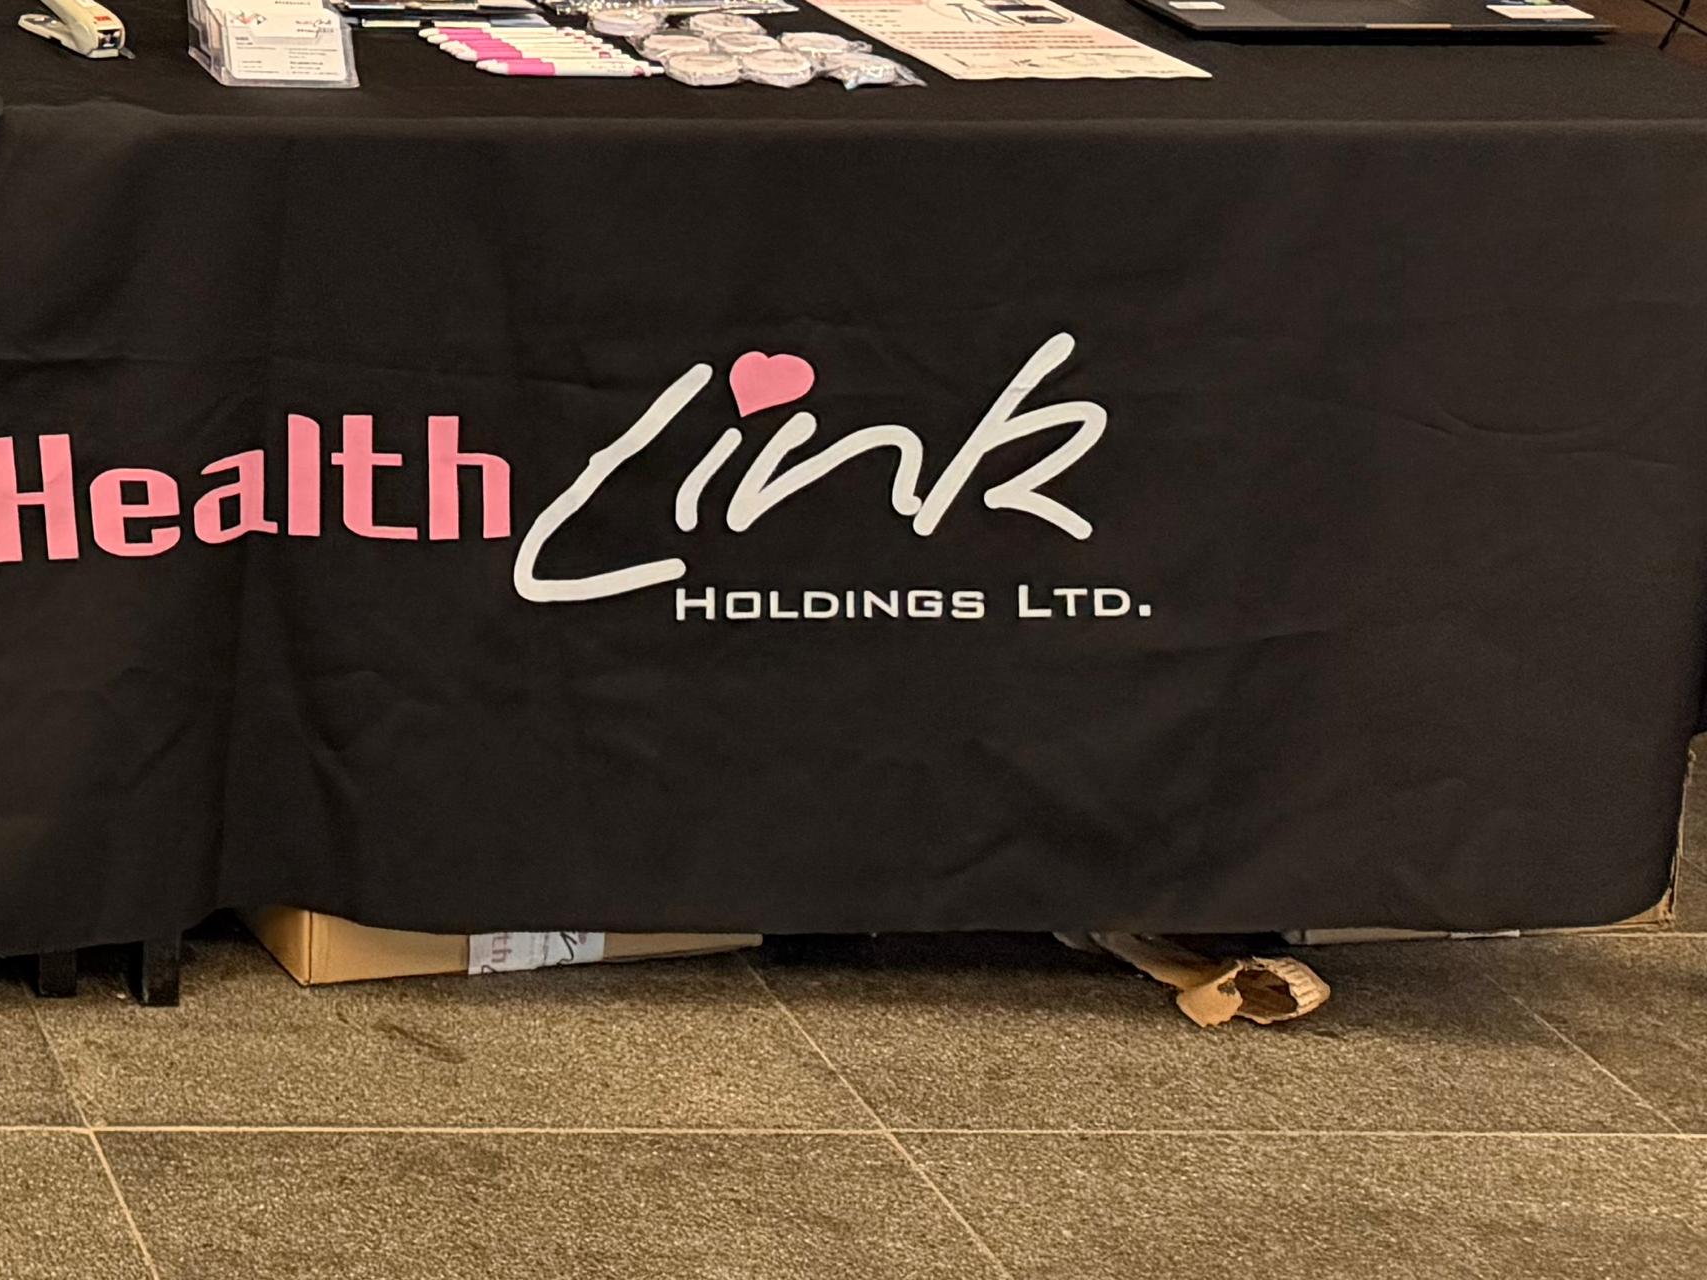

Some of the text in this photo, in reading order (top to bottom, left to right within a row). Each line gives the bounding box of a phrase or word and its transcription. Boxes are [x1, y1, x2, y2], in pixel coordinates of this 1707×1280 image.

[512, 332, 1108, 603] Link
[676, 584, 1153, 621] HOLDINGS LTD.
